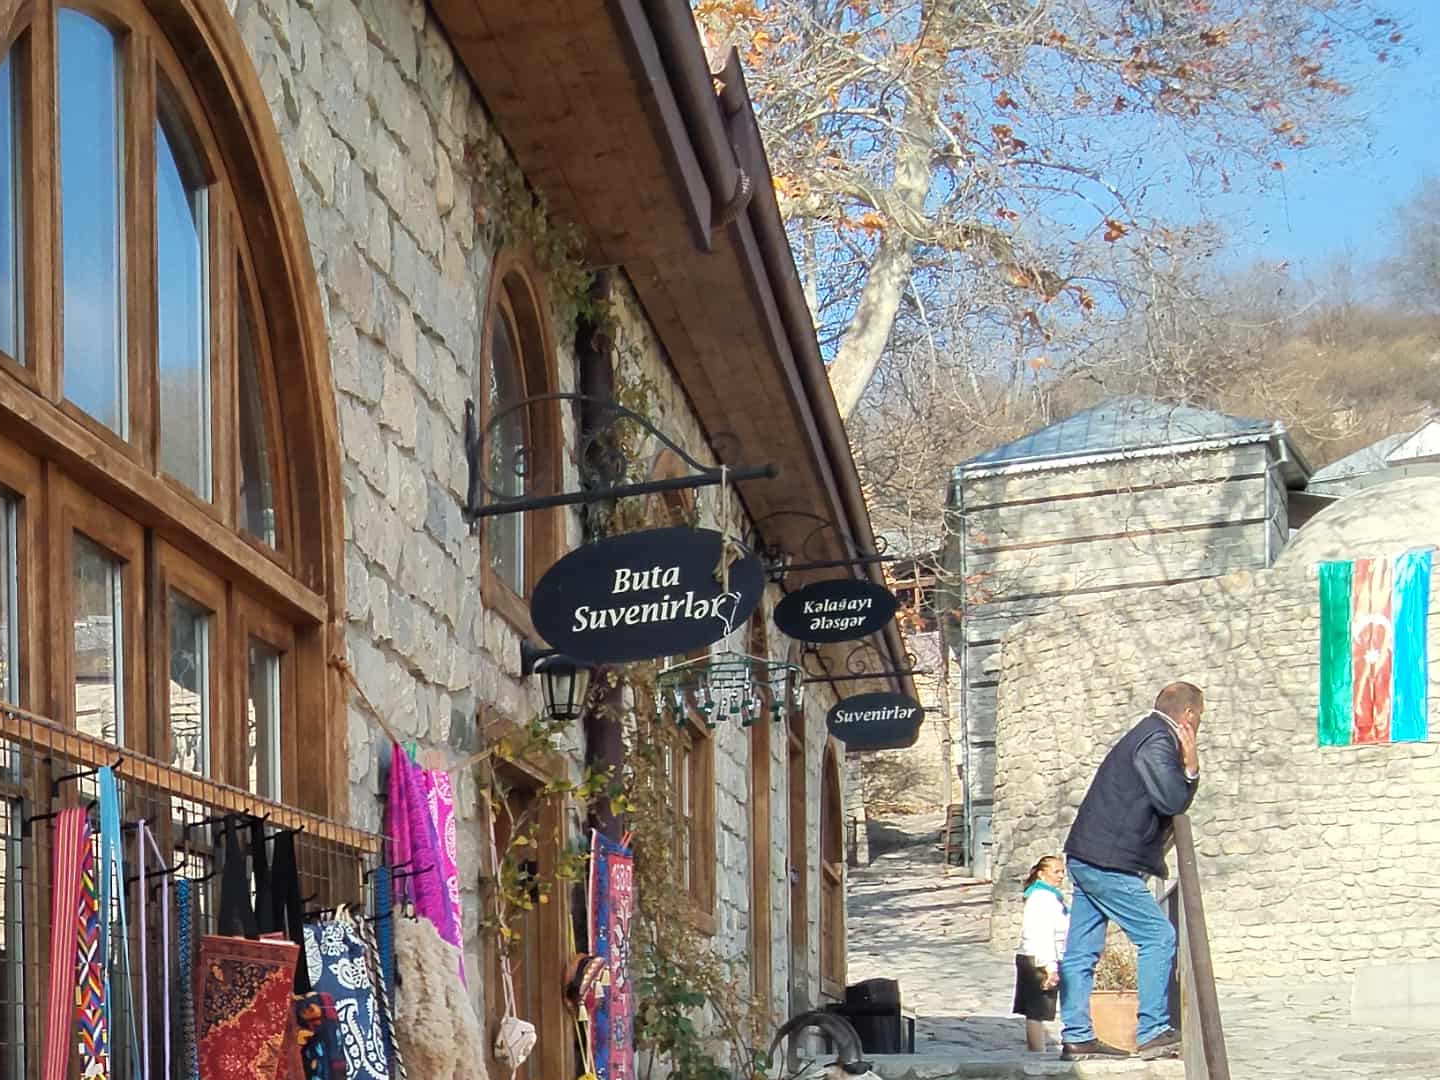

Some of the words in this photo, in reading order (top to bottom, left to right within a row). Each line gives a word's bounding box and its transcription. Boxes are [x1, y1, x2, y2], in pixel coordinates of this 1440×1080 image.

[612, 566, 680, 594] Buta
[572, 591, 726, 632] Suvenirlər
[834, 706, 917, 724] Suvenirlər
